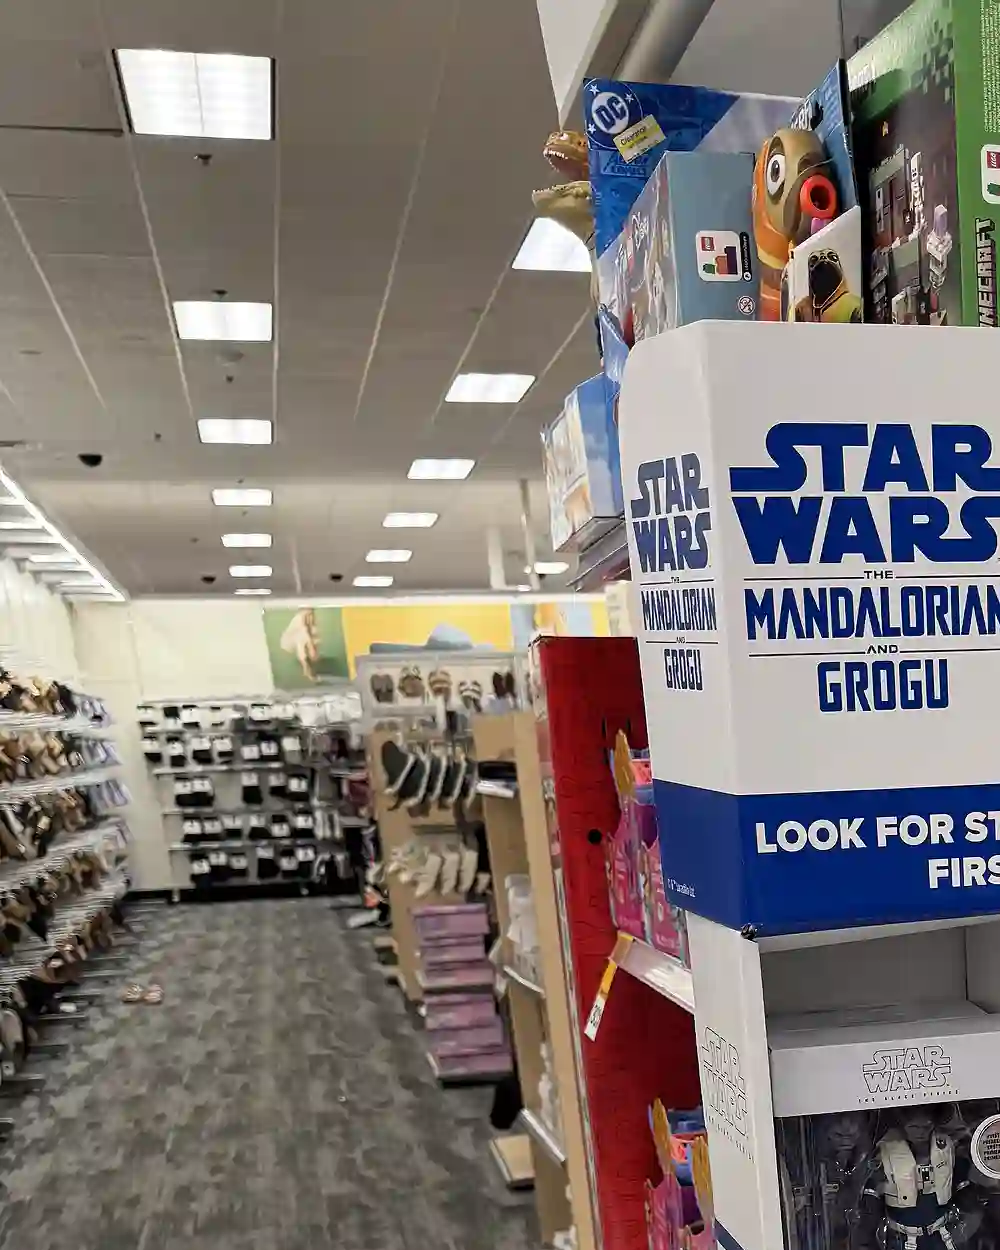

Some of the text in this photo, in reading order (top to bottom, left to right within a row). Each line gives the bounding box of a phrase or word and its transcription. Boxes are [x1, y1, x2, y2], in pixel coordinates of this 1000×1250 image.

[595, 96, 626, 131] DC
[630, 452, 710, 518] STAR
[632, 511, 713, 573] WARS
[863, 569, 894, 580] THE
[640, 586, 718, 632] MANDALORIAN
[663, 648, 704, 692] GROGU
[866, 644, 899, 655] AND
[816, 658, 949, 713] GROGU
[755, 816, 867, 855] LOOK
[875, 811, 955, 847] FOR
[862, 1045, 951, 1073] STAR
[863, 1066, 952, 1094] WARS
